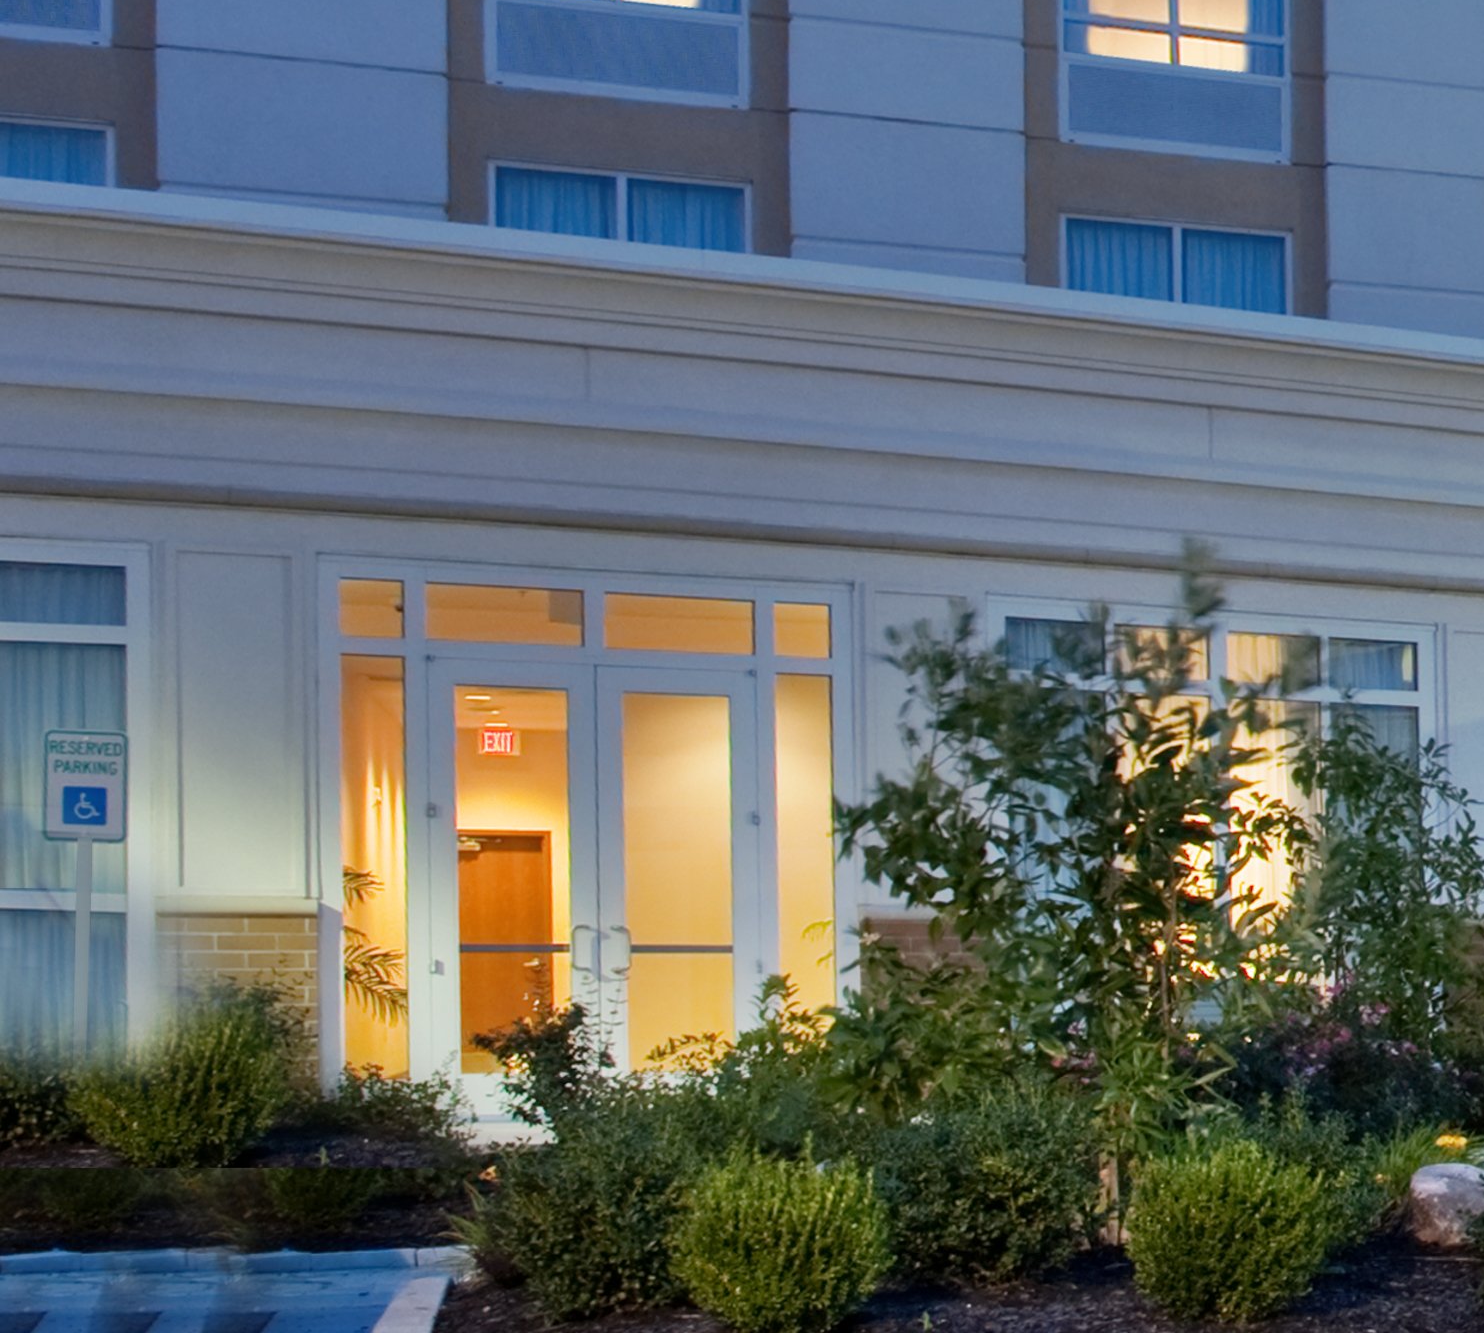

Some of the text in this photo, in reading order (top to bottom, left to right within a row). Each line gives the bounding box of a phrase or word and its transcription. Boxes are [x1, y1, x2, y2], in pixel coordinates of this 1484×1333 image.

[49, 739, 122, 757] RESERVED
[484, 731, 512, 753] EXIT
[53, 759, 118, 776] PARKING
